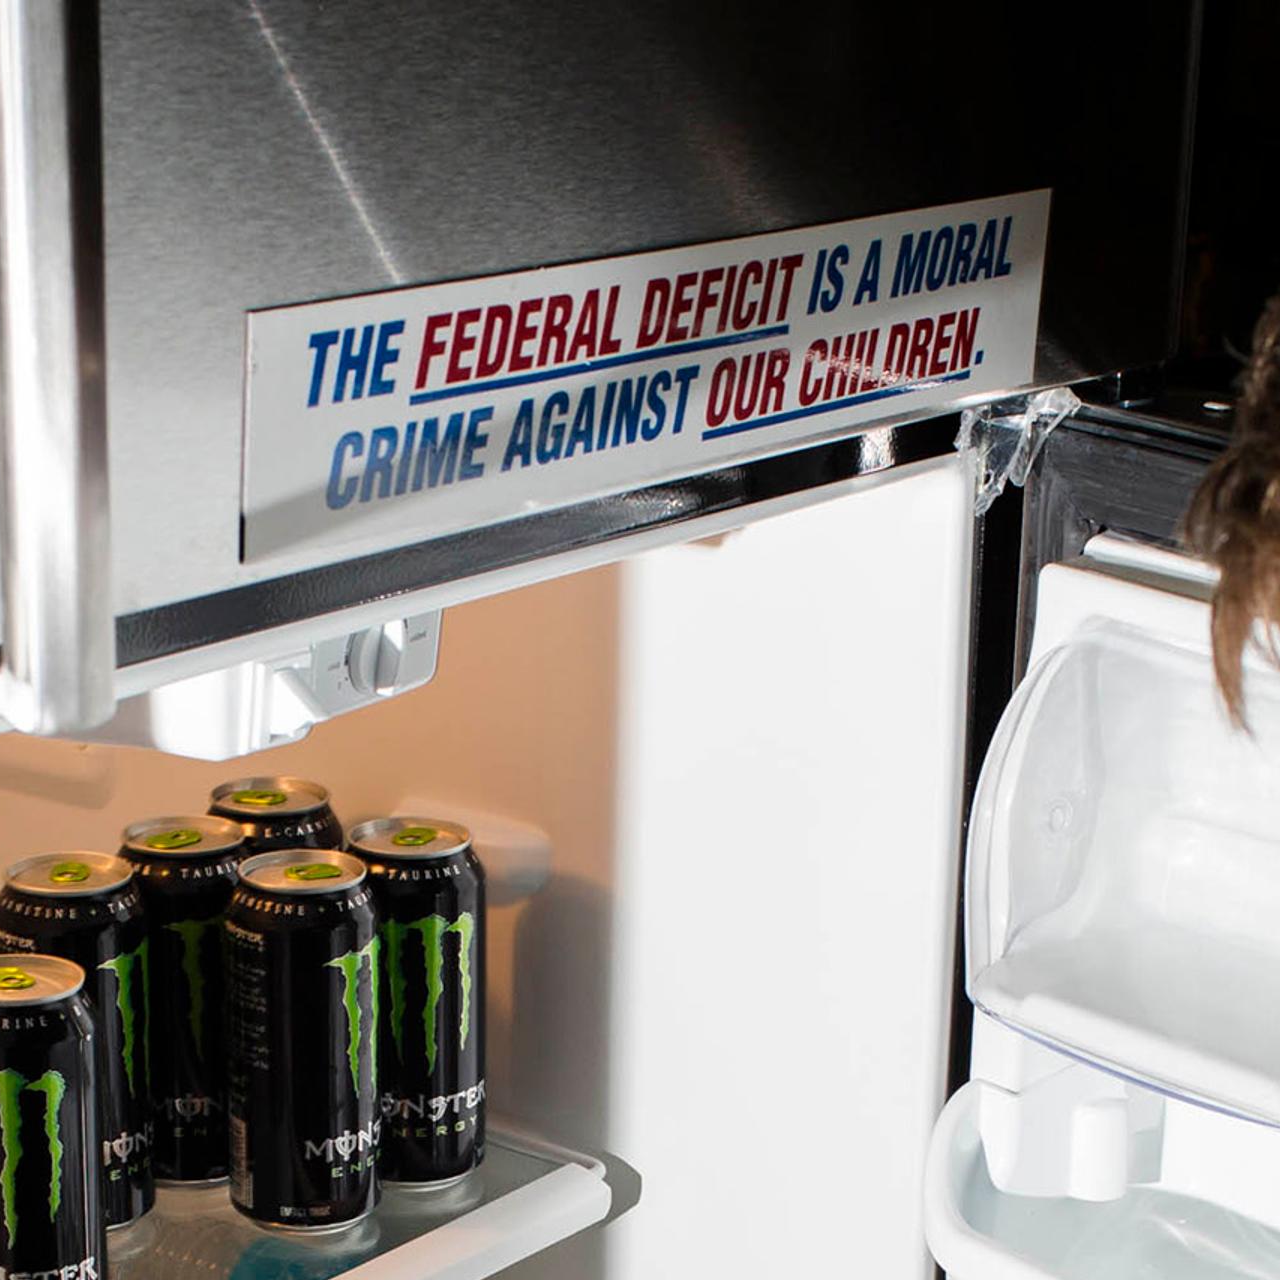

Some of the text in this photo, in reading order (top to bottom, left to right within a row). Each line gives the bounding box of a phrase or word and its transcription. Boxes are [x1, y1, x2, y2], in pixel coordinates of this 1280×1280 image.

[307, 215, 1013, 408] THE FEDERAL DEFICIT IS A MORAL
[325, 307, 984, 510] CRIME AGAINST OUR CHILDREN.
[387, 864, 461, 880] TAURINE
[392, 1115, 478, 1138] NERGY
